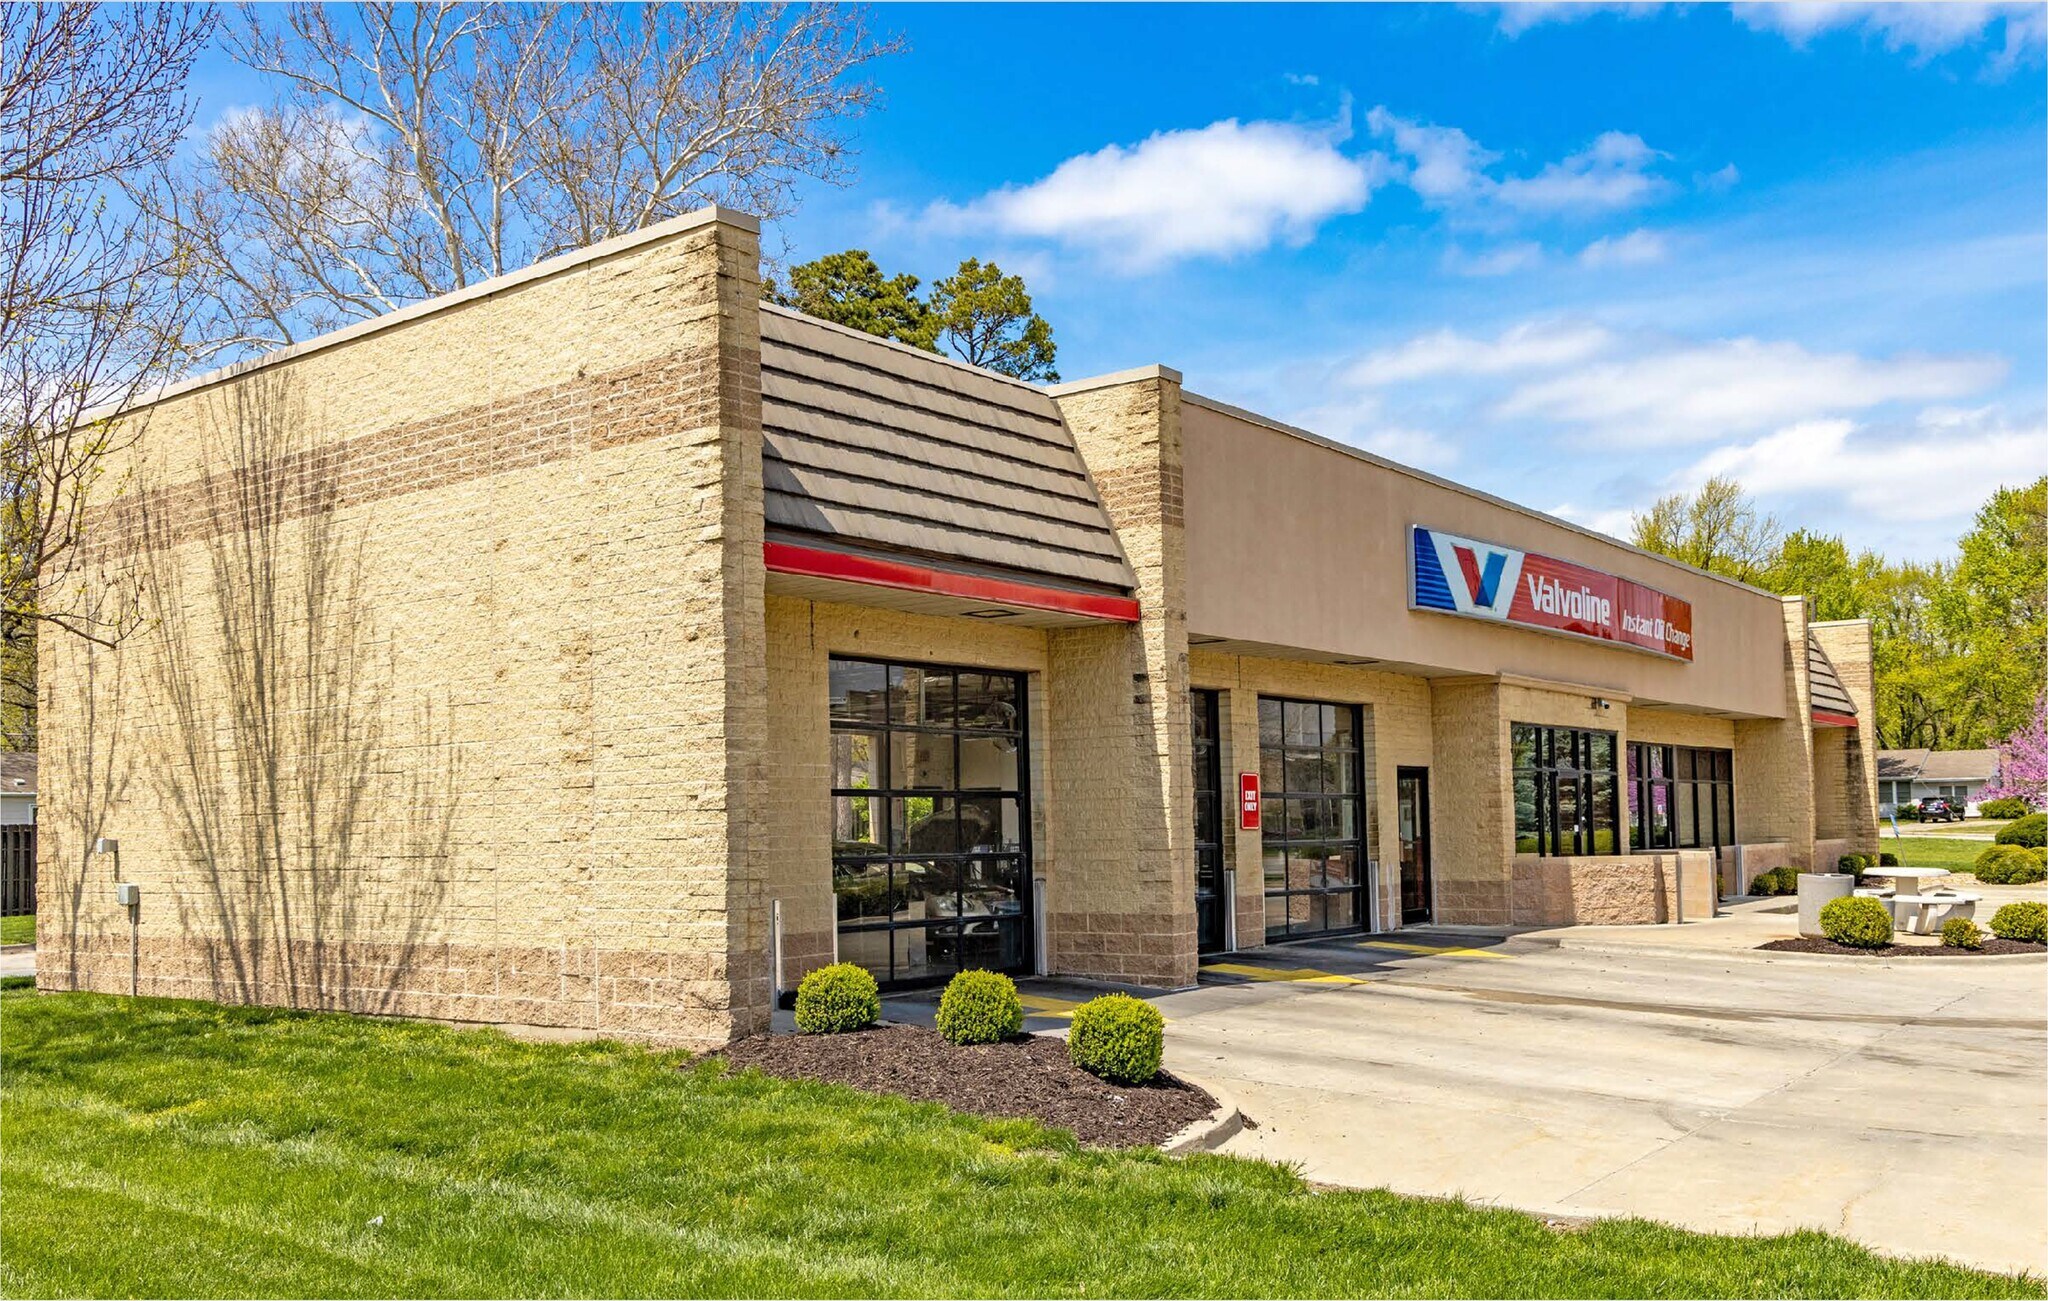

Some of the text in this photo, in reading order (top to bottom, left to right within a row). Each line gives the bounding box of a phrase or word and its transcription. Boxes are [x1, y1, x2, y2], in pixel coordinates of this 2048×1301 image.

[1526, 573, 1611, 627] Valvoline
[1622, 609, 1691, 651] Instant Oil Change
[1245, 790, 1256, 801] EXIT
[1245, 802, 1257, 812] ONLY
